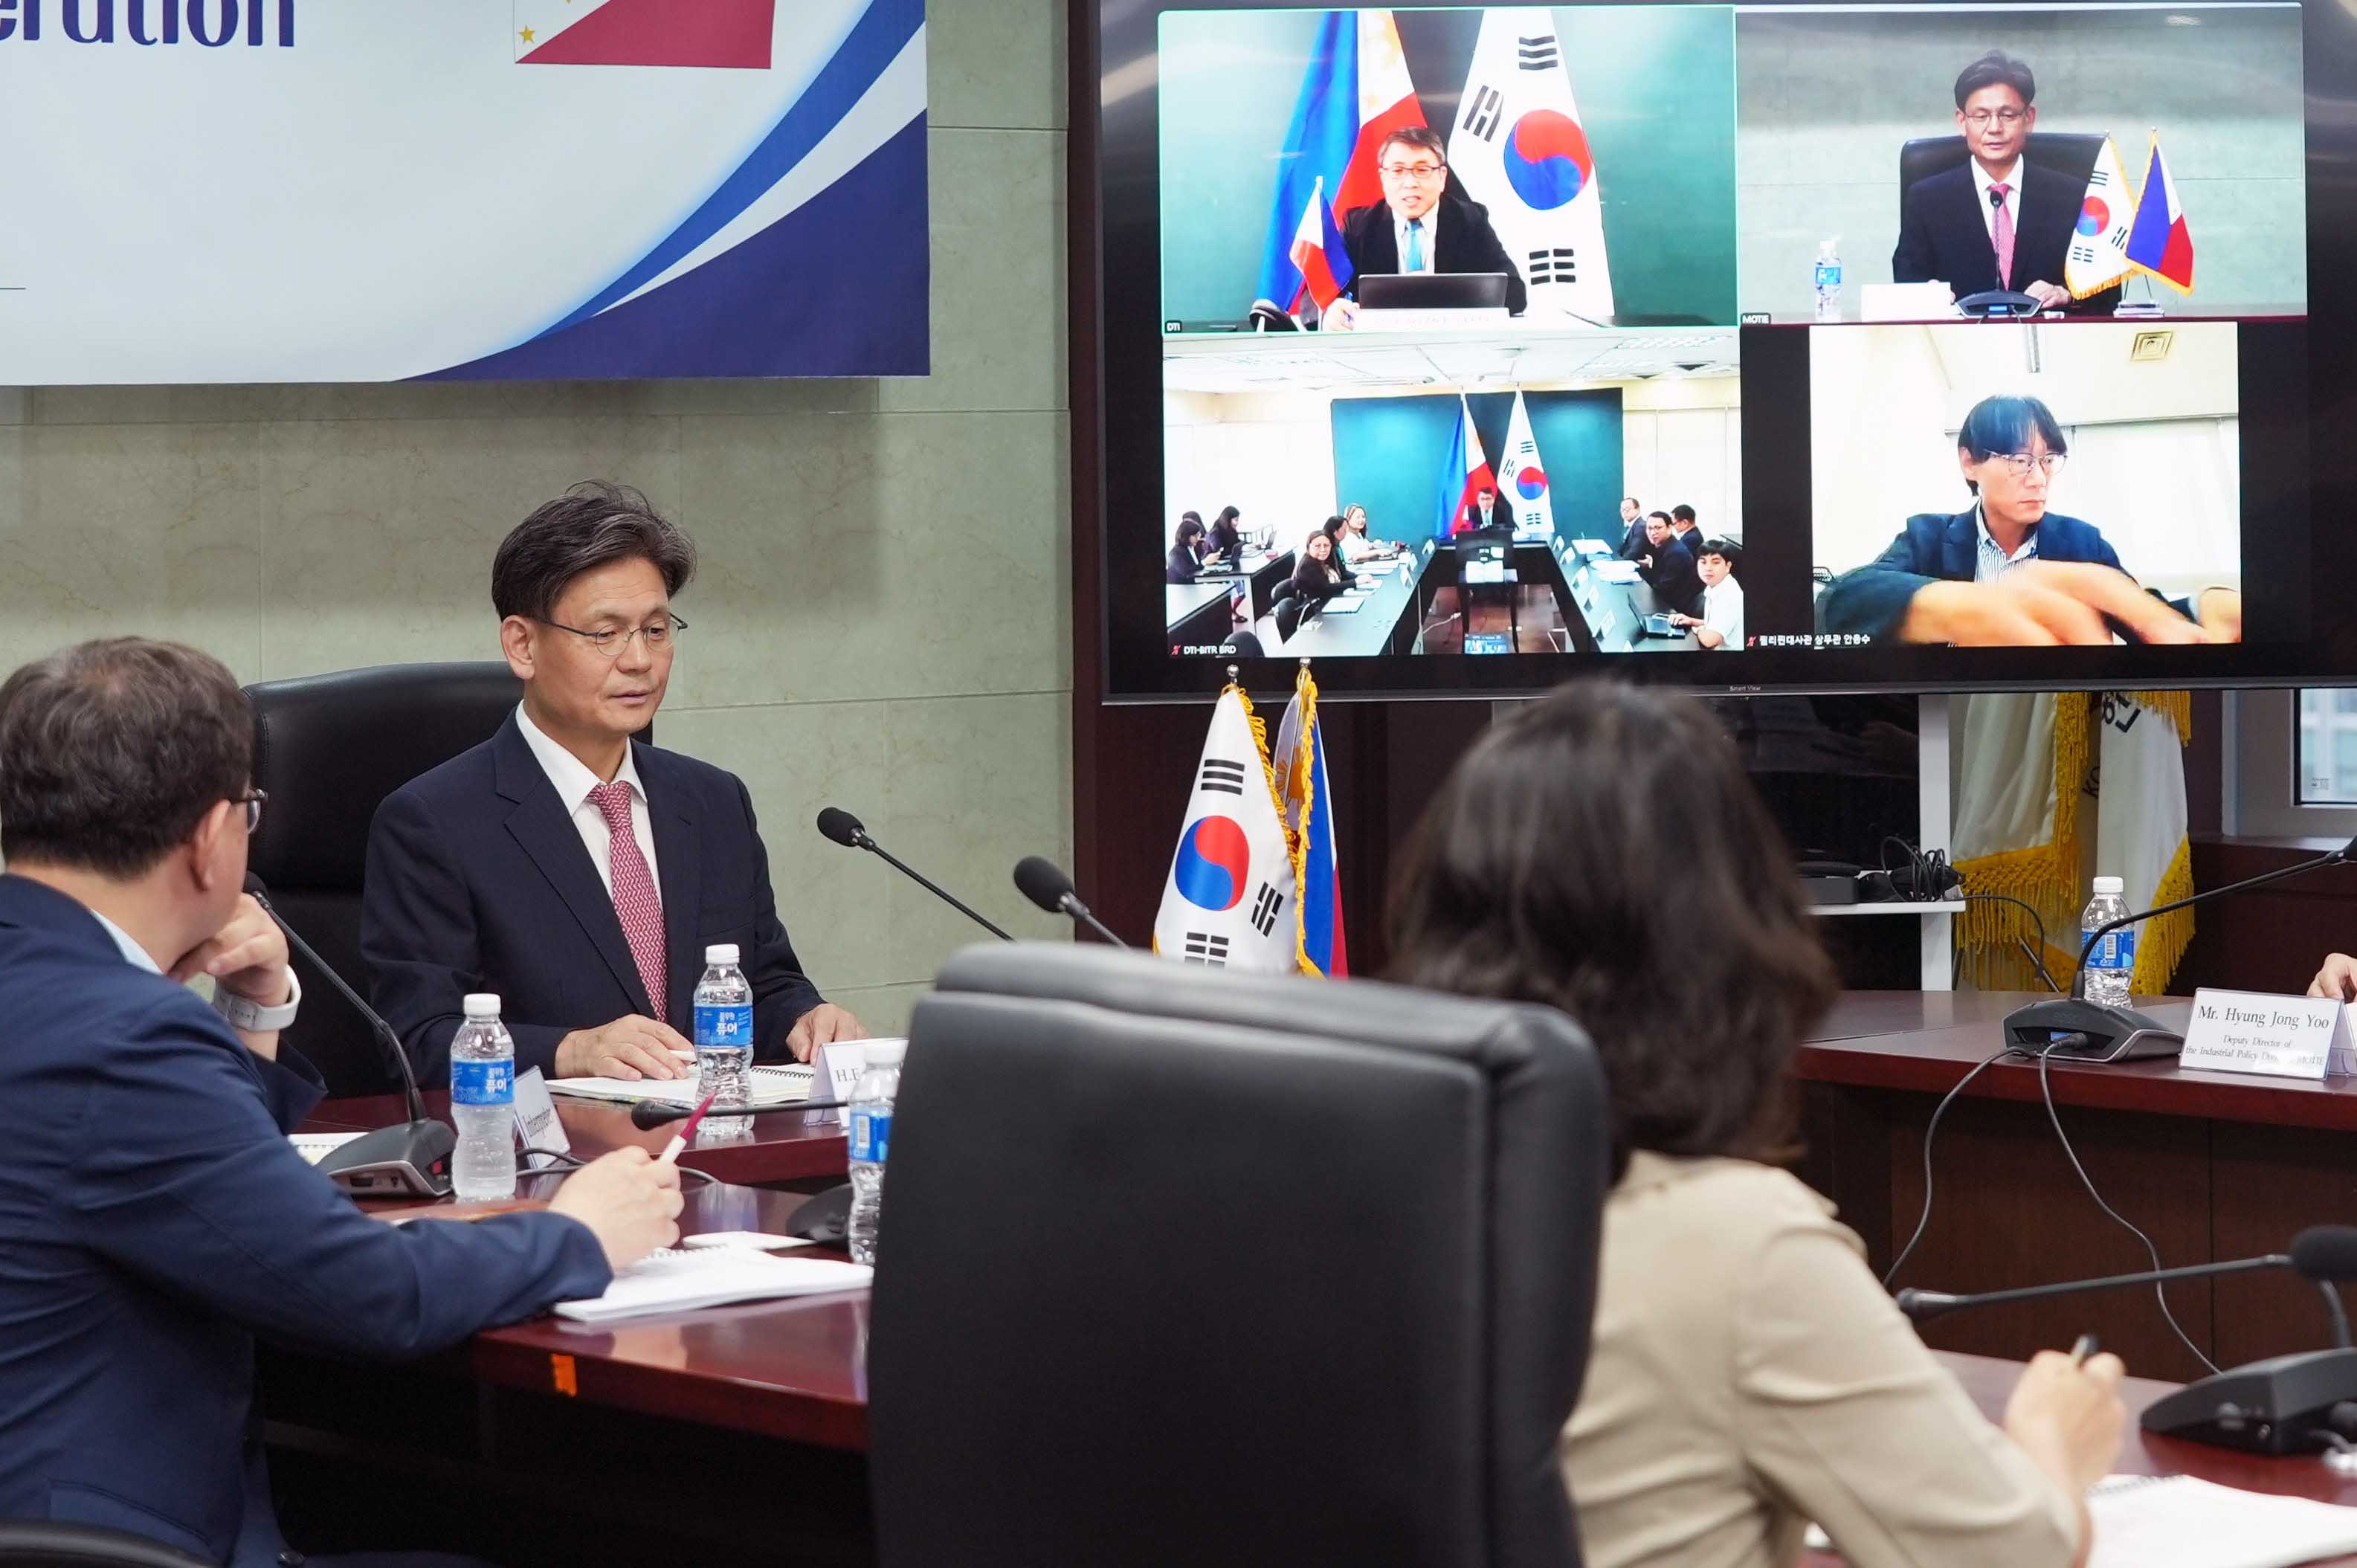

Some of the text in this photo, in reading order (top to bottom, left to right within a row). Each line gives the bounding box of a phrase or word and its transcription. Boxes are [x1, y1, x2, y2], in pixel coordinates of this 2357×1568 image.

[1742, 314, 1770, 324] MOTIE
[1167, 322, 1181, 332] DTI
[1814, 633, 1842, 645] 상무관
[1183, 645, 1236, 654] DTI-BITR BRD
[2198, 1005, 2329, 1030] Mr. Hyung Jong Yoo
[716, 1022, 738, 1036] 퓨어
[2223, 1034, 2292, 1048] Deputy Director of
[2185, 1045, 2197, 1054] the
[2200, 1046, 2234, 1057] Industrial
[2237, 1048, 2257, 1062] Policy
[486, 1077, 507, 1094] 퓨어
